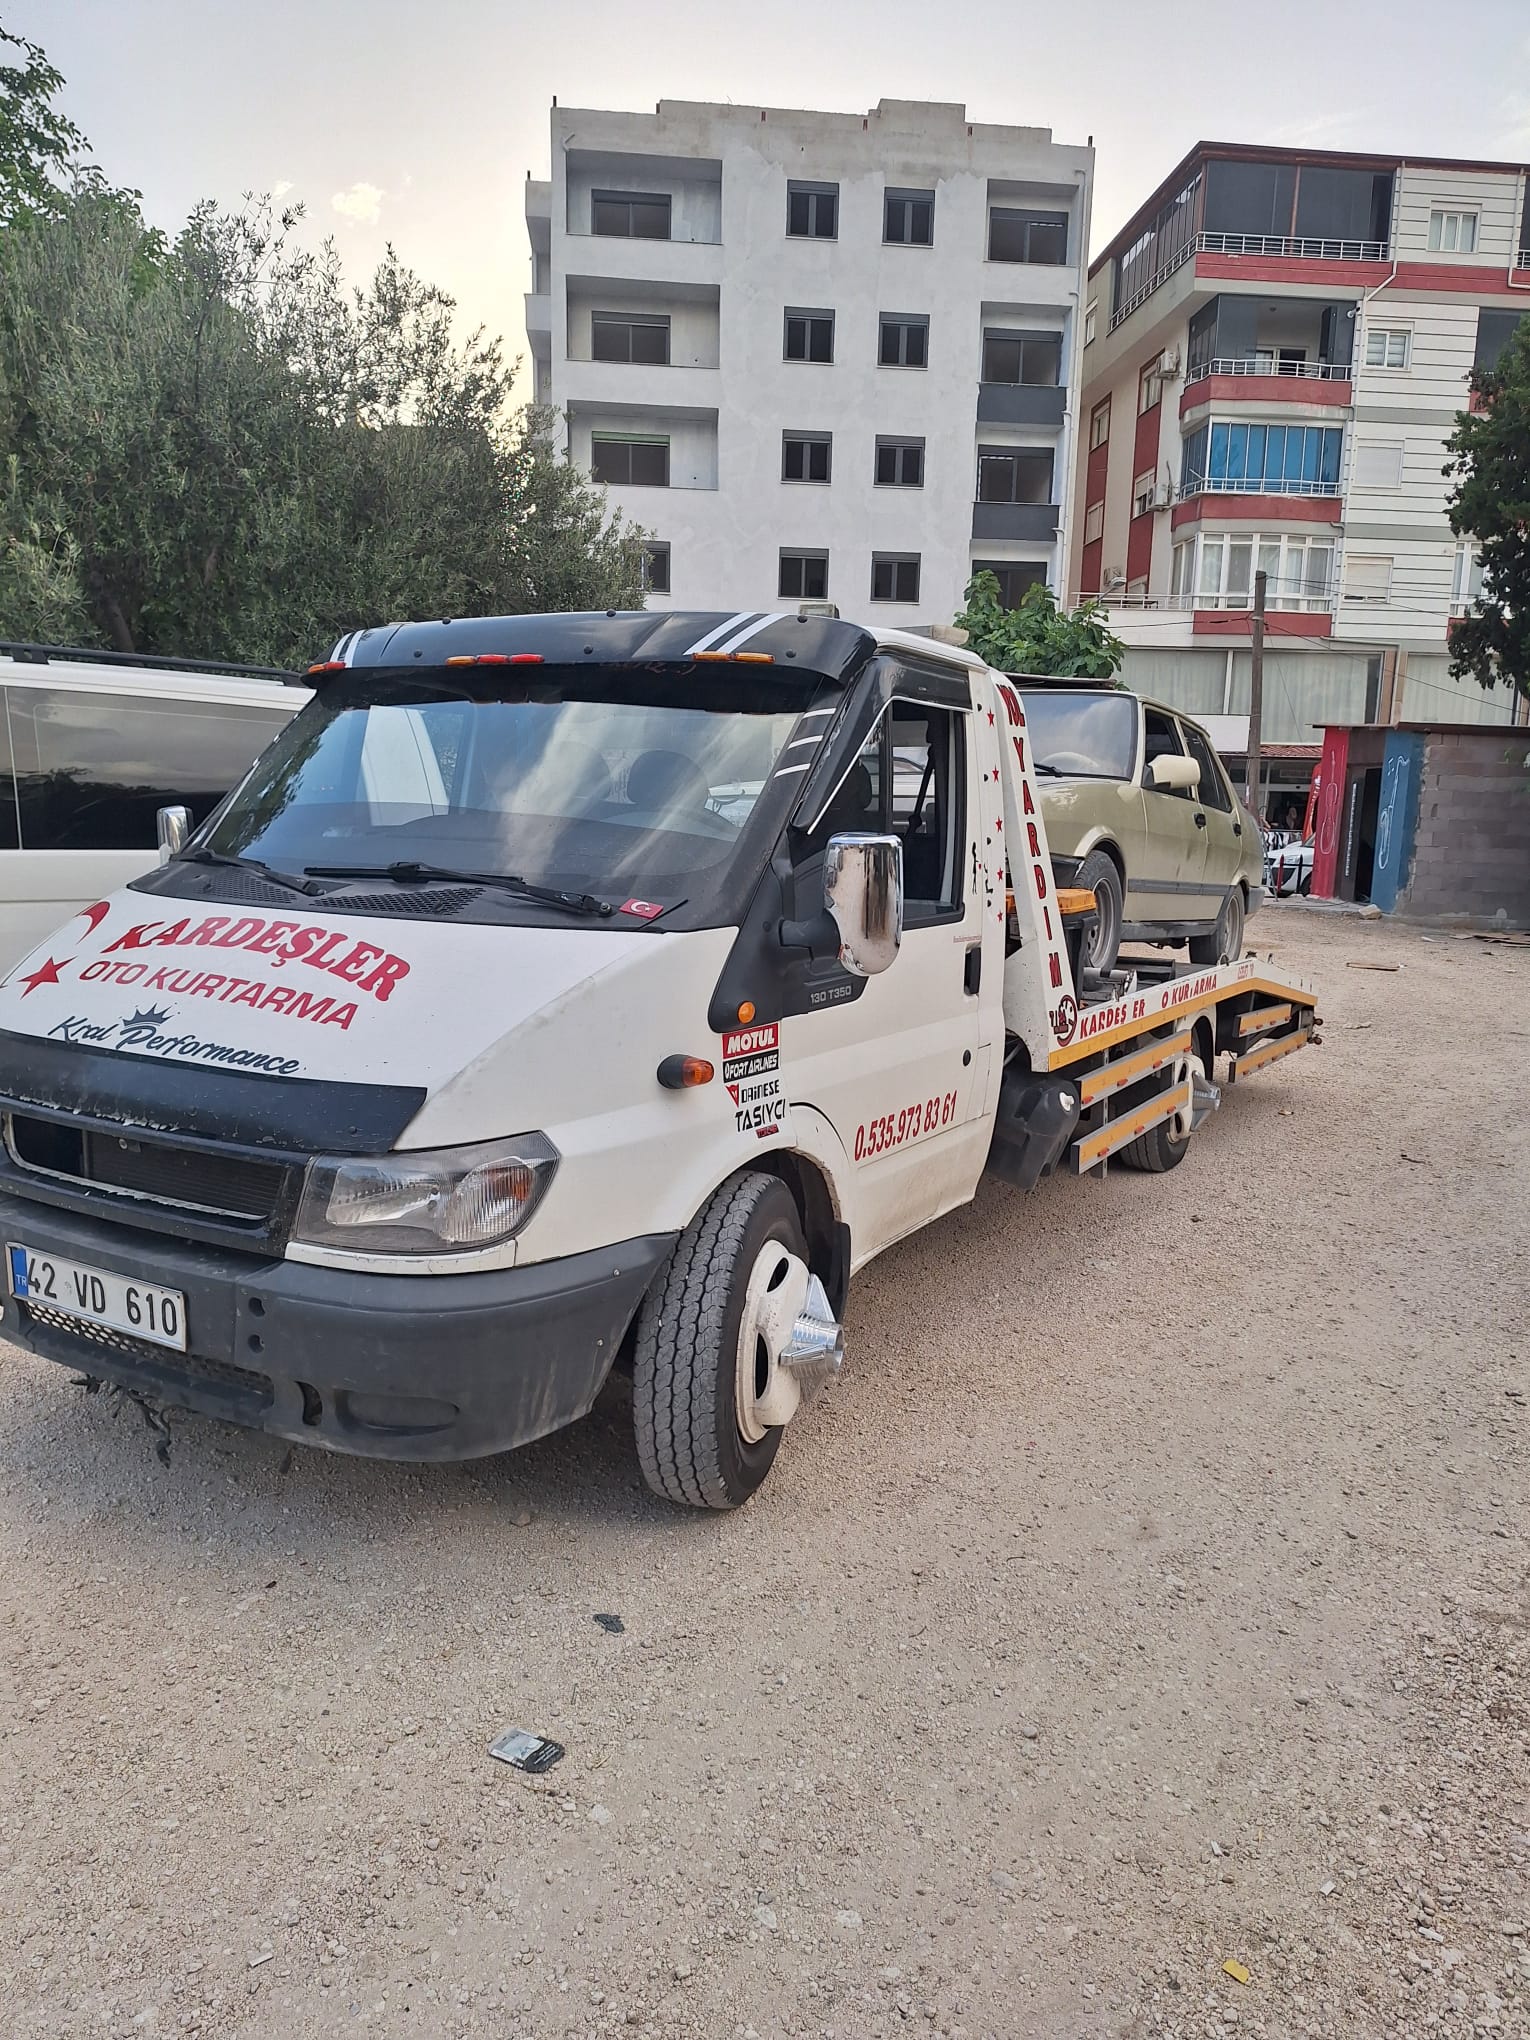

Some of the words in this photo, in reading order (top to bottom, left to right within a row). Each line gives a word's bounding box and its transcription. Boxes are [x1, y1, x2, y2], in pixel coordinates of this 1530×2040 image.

[1012, 736, 1063, 988] YARDIM
[100, 915, 411, 1002] KARDEŞLER
[78, 960, 148, 984] OTO
[142, 965, 360, 1030] KURTARMA
[810, 991, 827, 1004] 130
[828, 985, 852, 1000] T350
[47, 1015, 119, 1044] Kral
[115, 1024, 300, 1075] Performance
[726, 1027, 775, 1055] MOTUL
[923, 1096, 941, 1133] 83
[941, 1089, 958, 1126] 61
[16, 1273, 28, 1287] TR
[27, 1257, 58, 1300] 42
[73, 1269, 106, 1314] VD
[125, 1286, 178, 1337] 610
